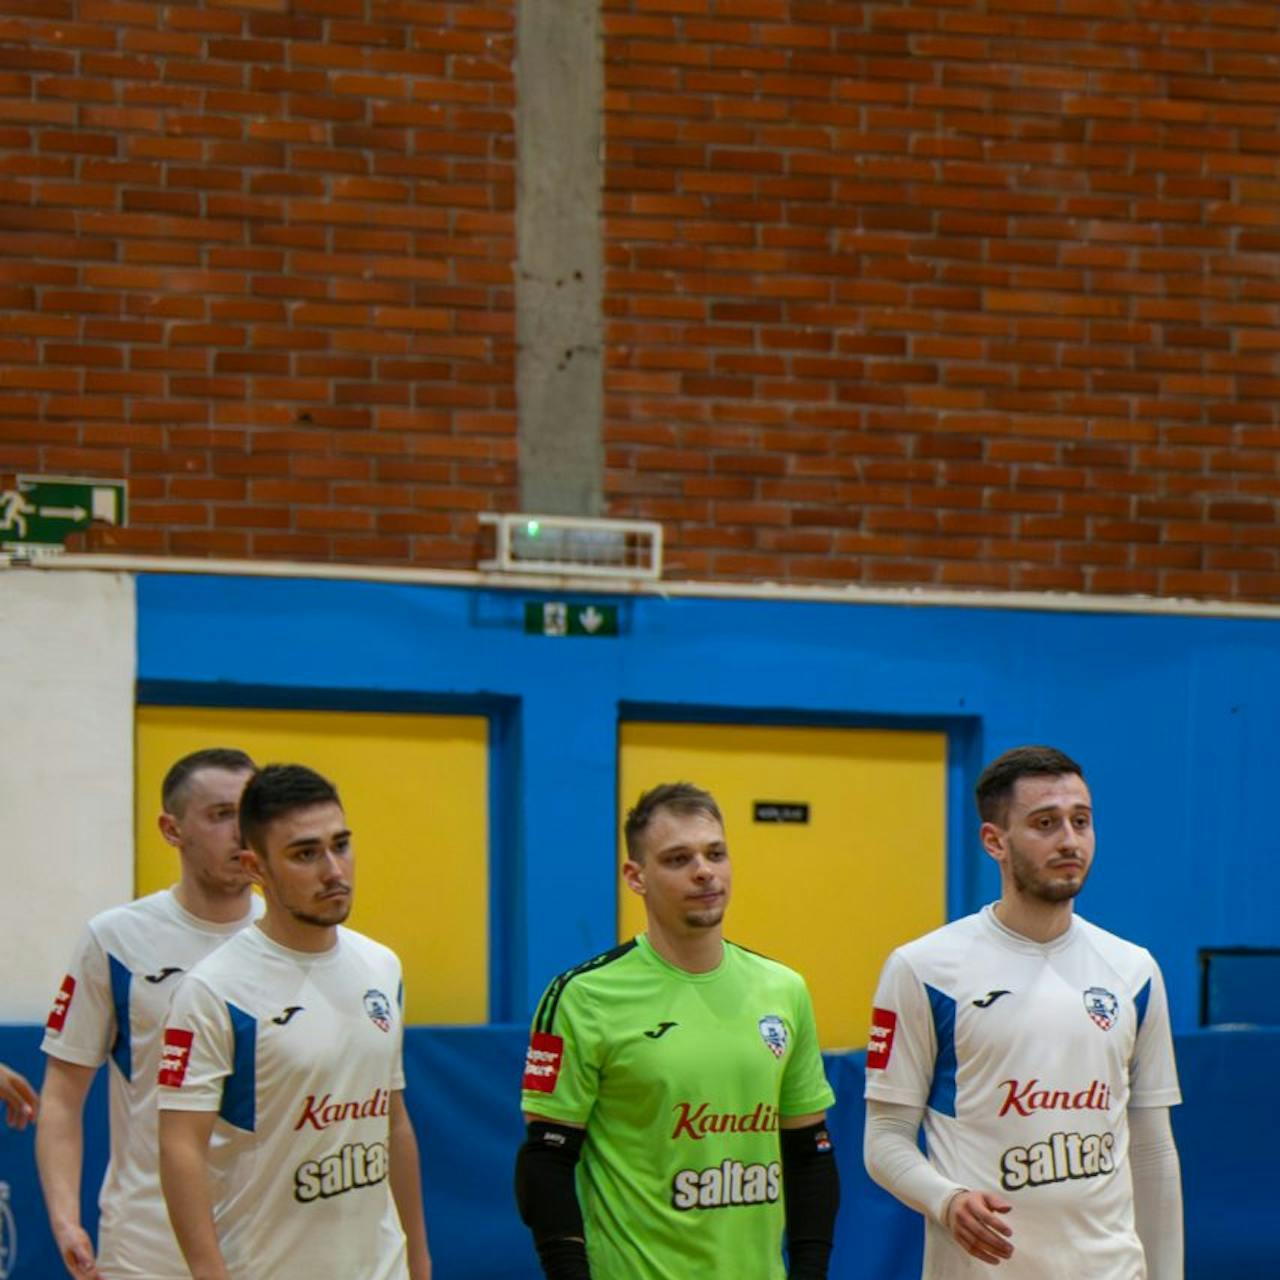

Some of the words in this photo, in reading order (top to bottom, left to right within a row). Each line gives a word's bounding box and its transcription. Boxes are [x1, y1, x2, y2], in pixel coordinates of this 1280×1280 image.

[295, 1089, 388, 1131] Kandi
[295, 1142, 389, 1204] salta
[673, 1158, 780, 1211] saltas
[1001, 1132, 1116, 1191] saltas
